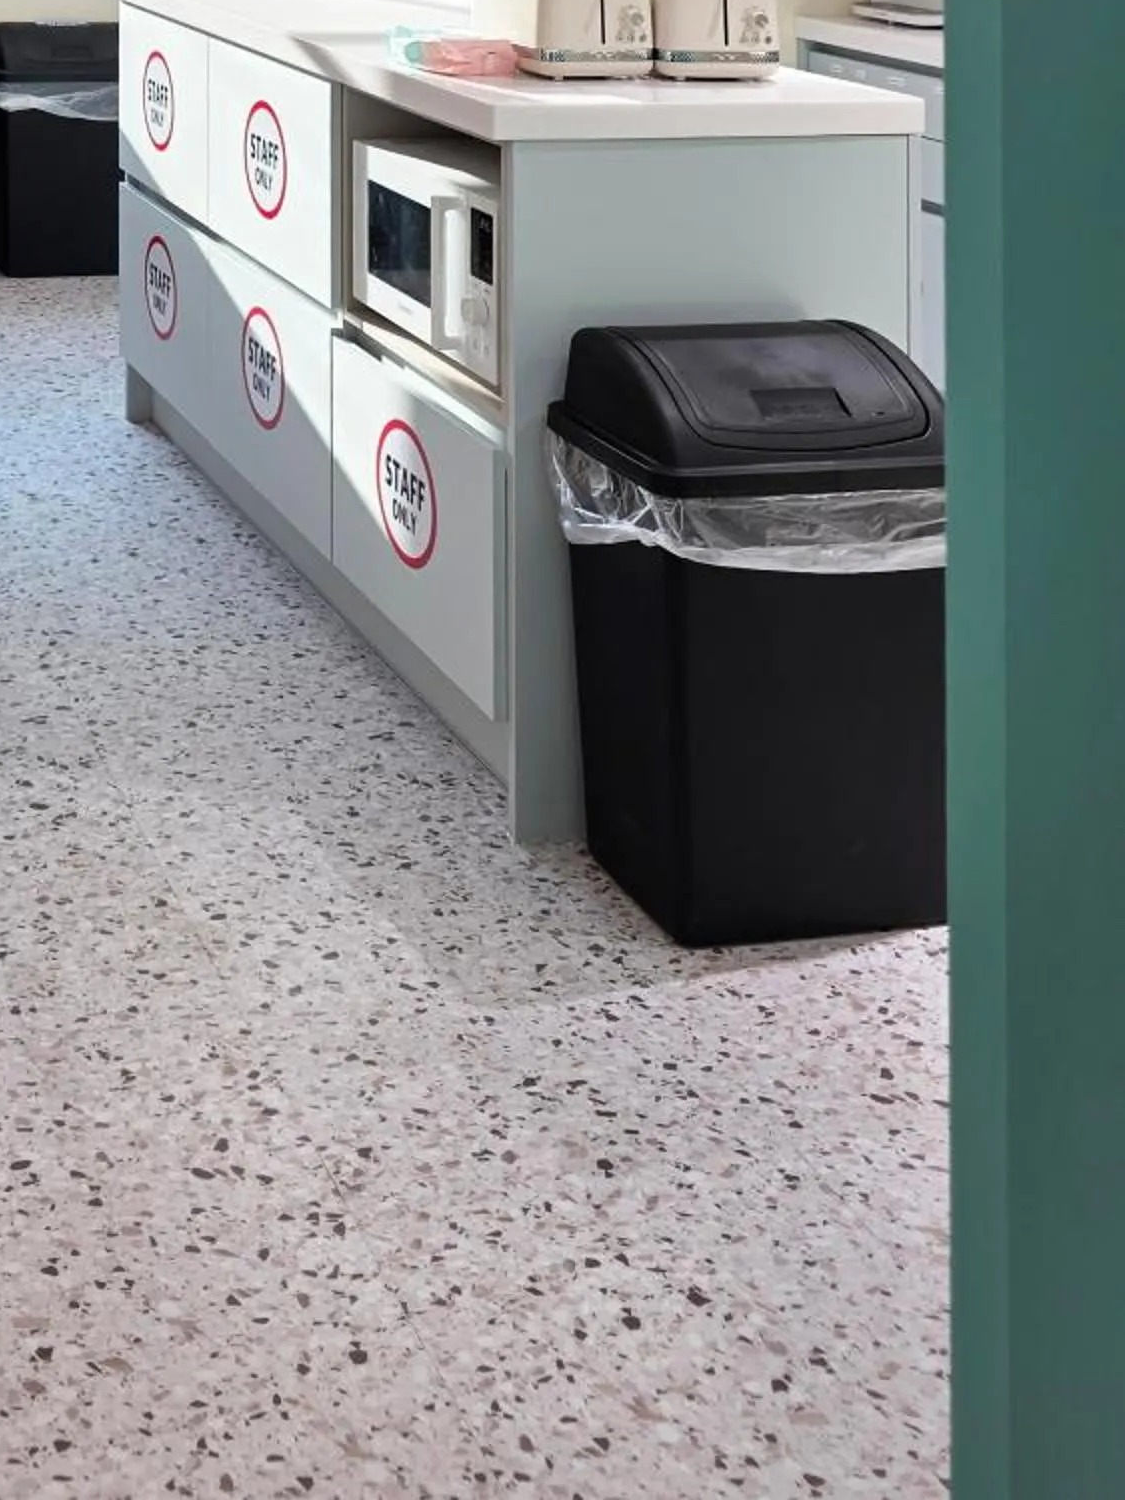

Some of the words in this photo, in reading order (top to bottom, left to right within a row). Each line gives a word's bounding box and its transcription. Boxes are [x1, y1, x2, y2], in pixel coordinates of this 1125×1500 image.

[148, 79, 168, 108] STAFF
[251, 133, 279, 169] STAFF
[150, 263, 171, 298] STAFF
[249, 336, 276, 381] STAFF
[385, 454, 426, 512] STAFF
[393, 498, 416, 536] ONLY
